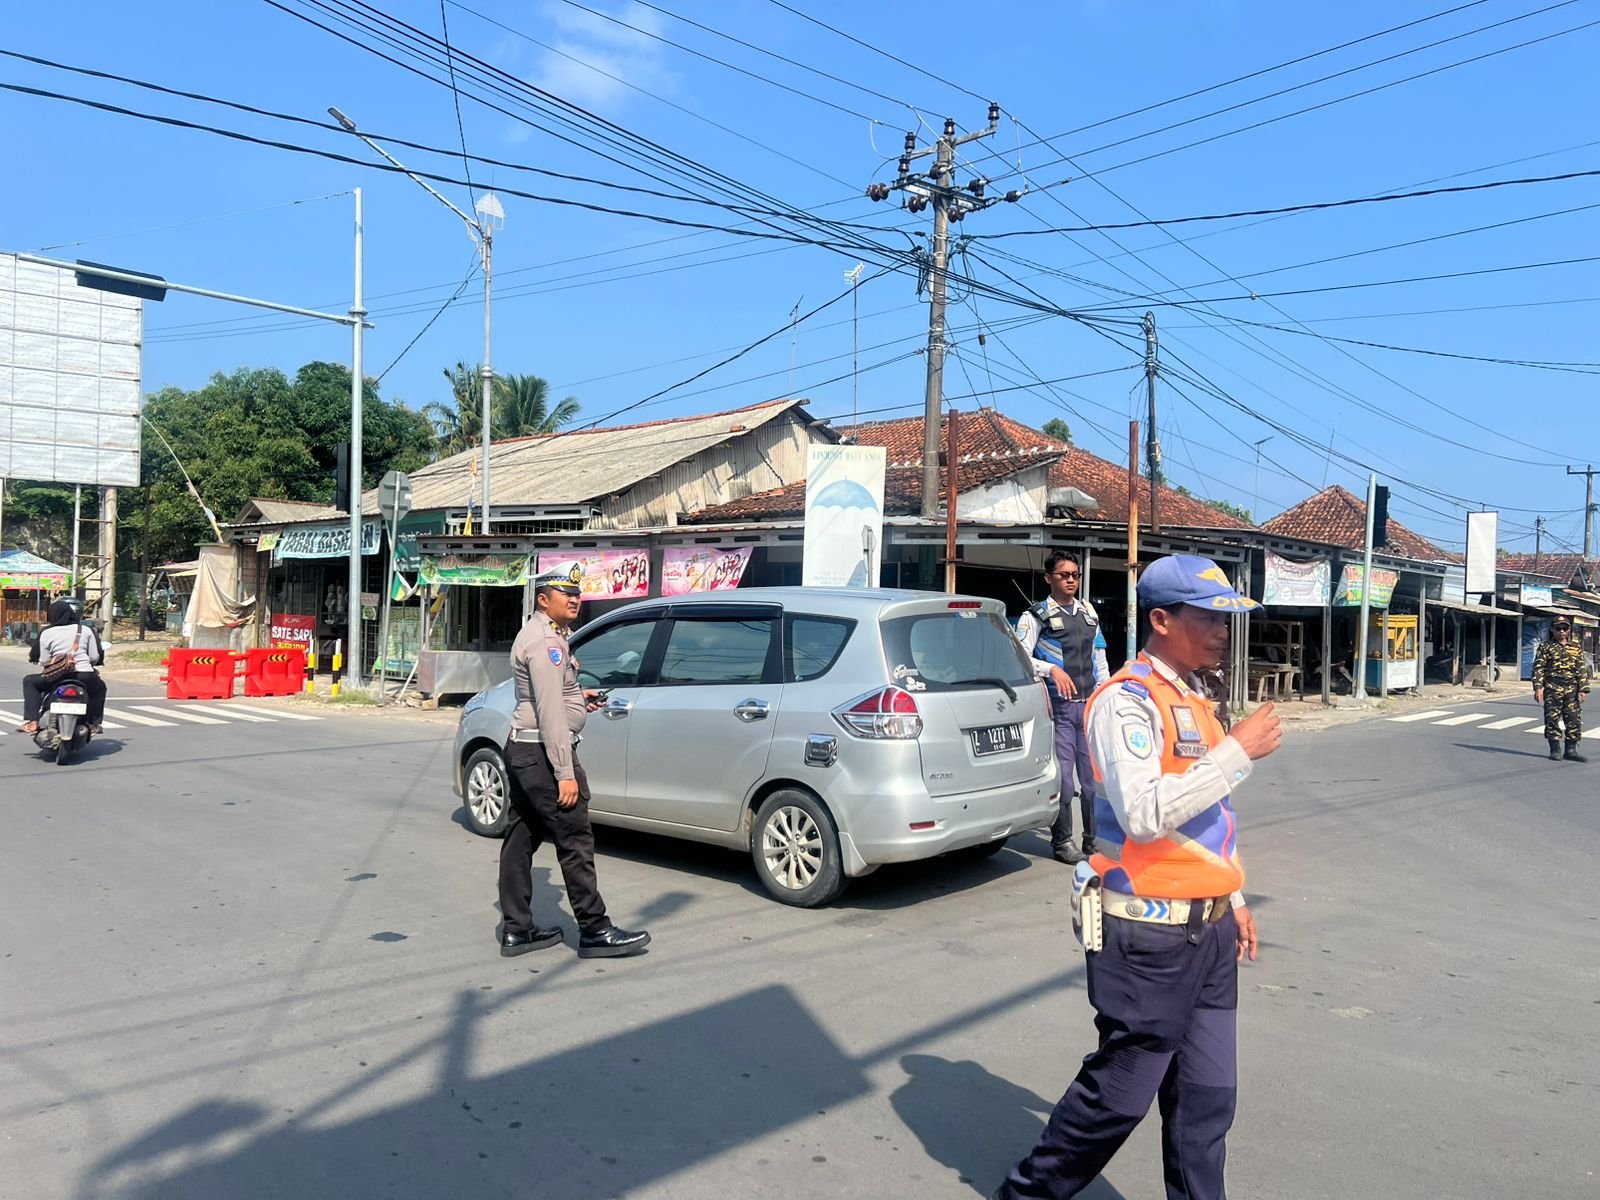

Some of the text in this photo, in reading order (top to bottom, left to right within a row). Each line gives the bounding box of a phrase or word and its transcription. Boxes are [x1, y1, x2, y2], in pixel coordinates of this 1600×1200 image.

[272, 625, 291, 640] SATE
[973, 730, 980, 746] Z
[988, 727, 1006, 744] 1277
